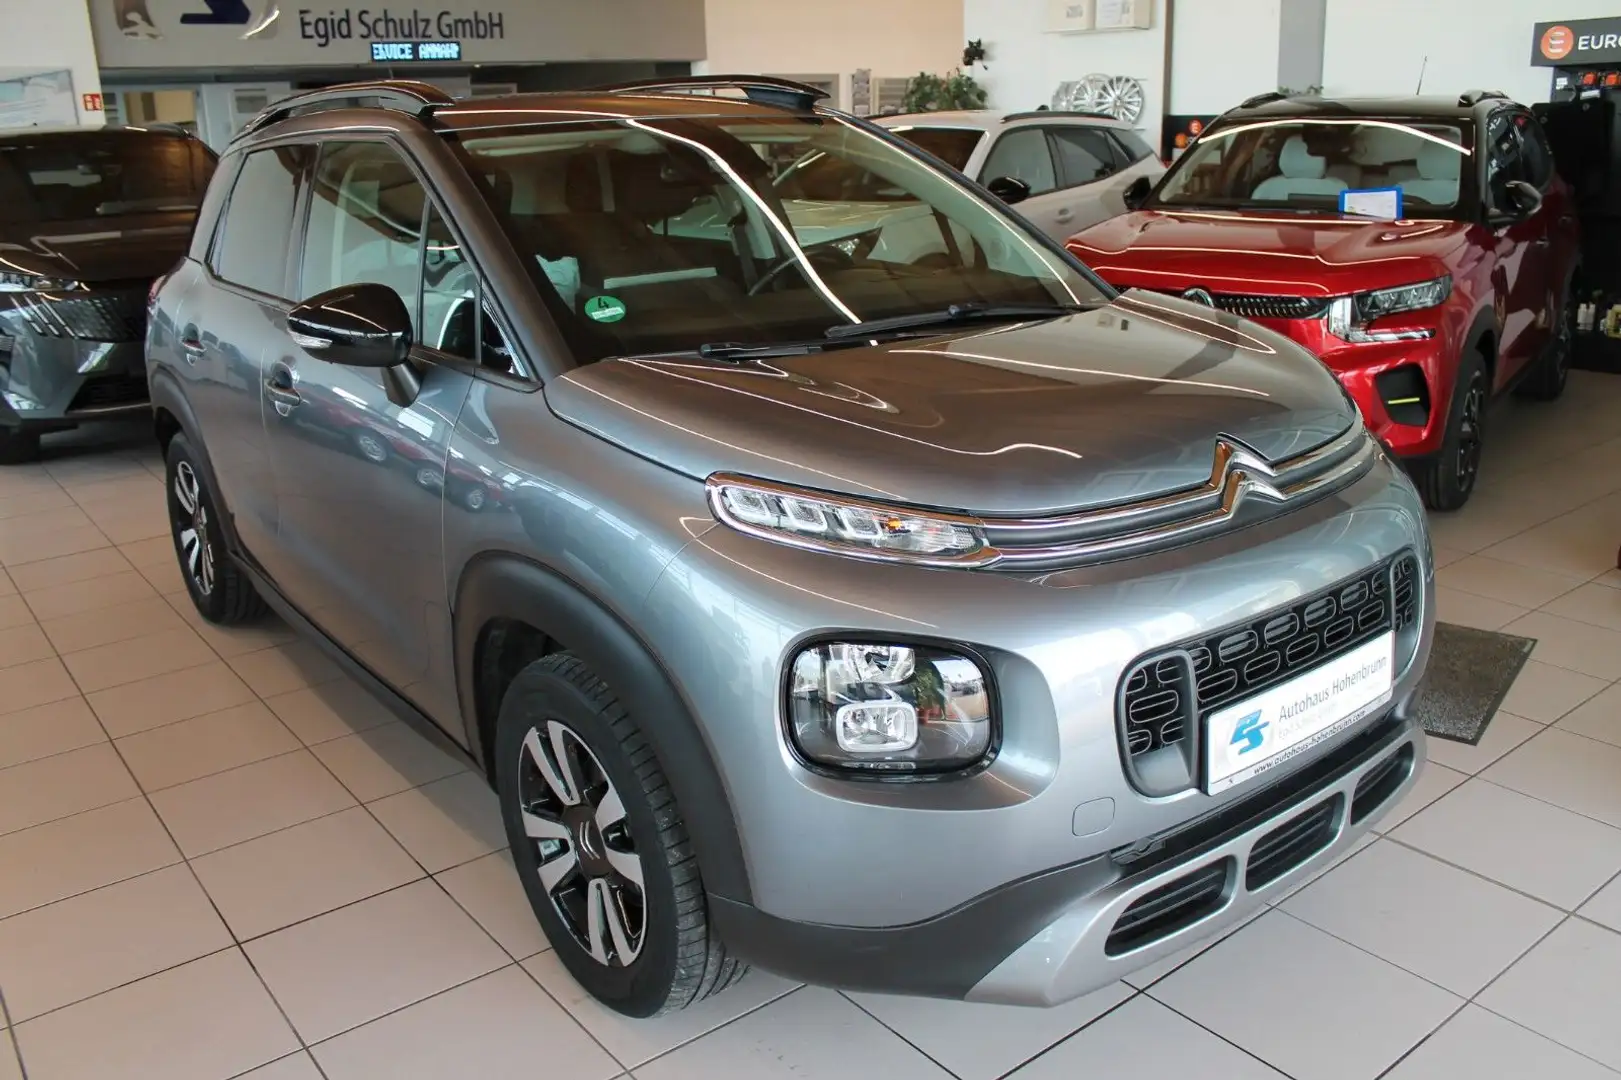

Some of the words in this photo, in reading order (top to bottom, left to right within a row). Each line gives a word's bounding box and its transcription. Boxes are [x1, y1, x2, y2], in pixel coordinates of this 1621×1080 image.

[299, 9, 352, 47] Egid
[358, 9, 432, 39] Schulz
[437, 11, 504, 39] GmbH
[1578, 33, 1621, 51] EUR
[1279, 687, 1330, 722] Autohaus
[1332, 655, 1387, 696] Hohenbrunn
